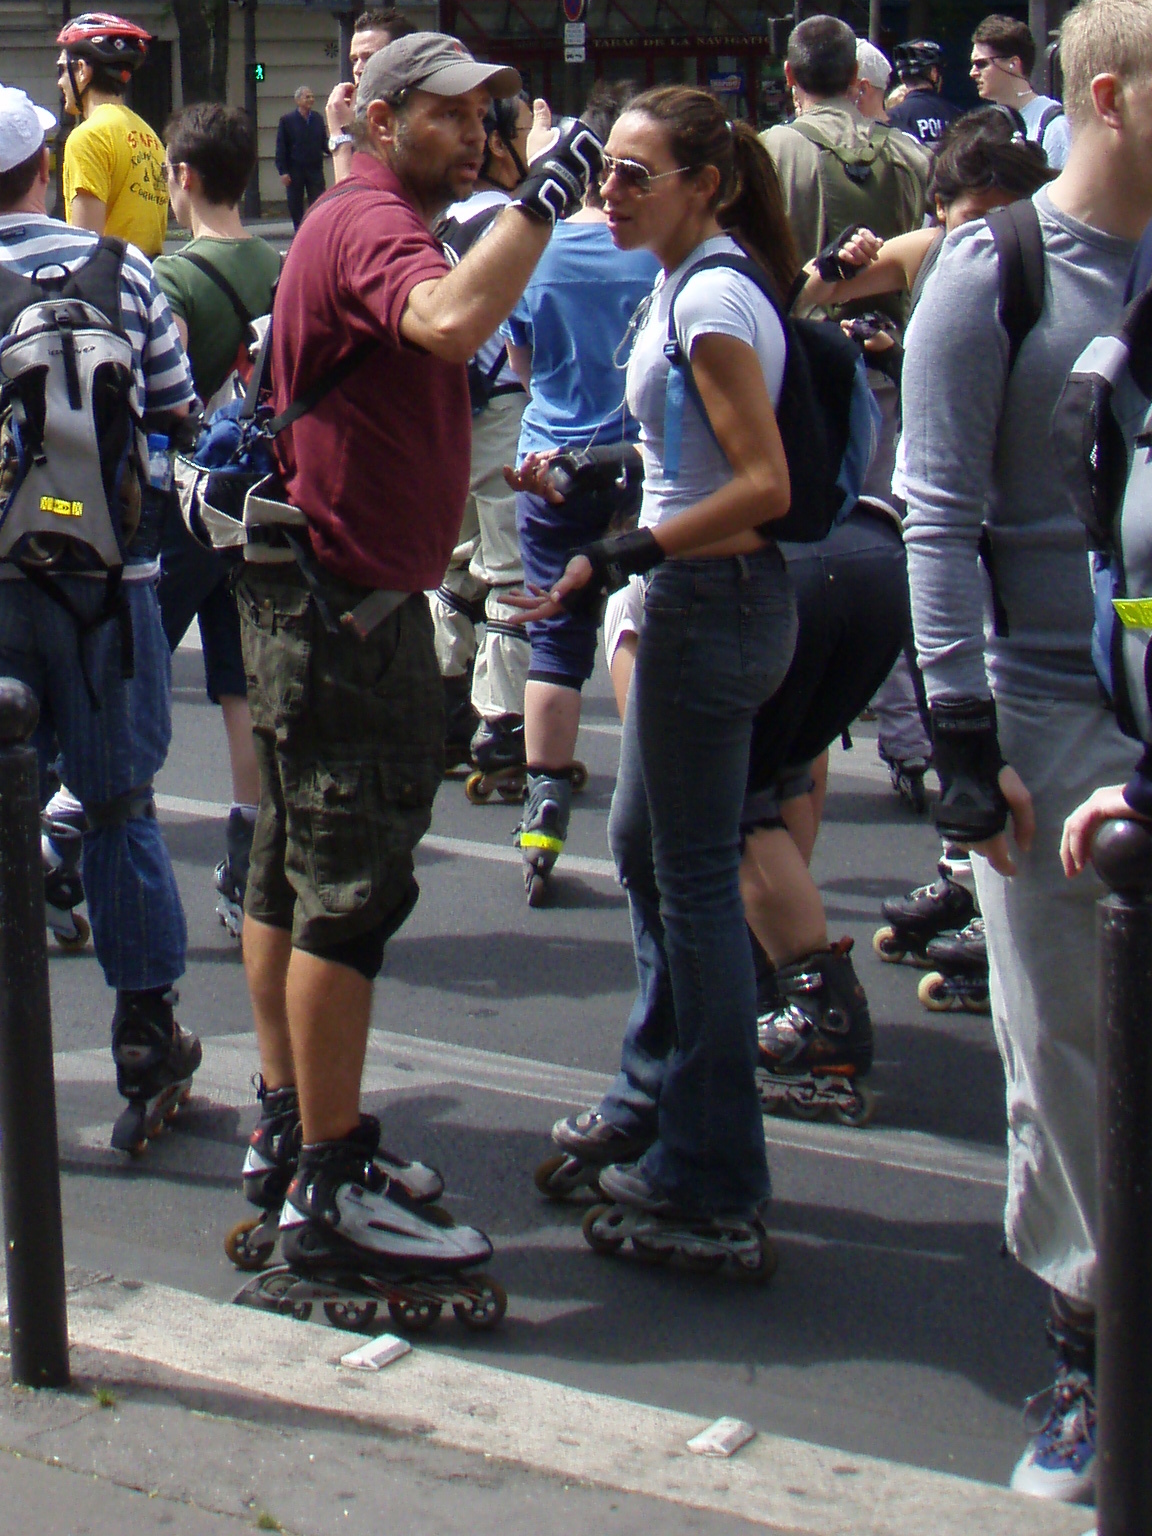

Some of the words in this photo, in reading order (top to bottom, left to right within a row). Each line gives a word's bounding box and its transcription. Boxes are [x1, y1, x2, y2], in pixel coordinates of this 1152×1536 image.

[593, 38, 638, 48] TABAC
[643, 38, 665, 47] DE
[670, 38, 689, 46] LA
[916, 117, 945, 139] POL
